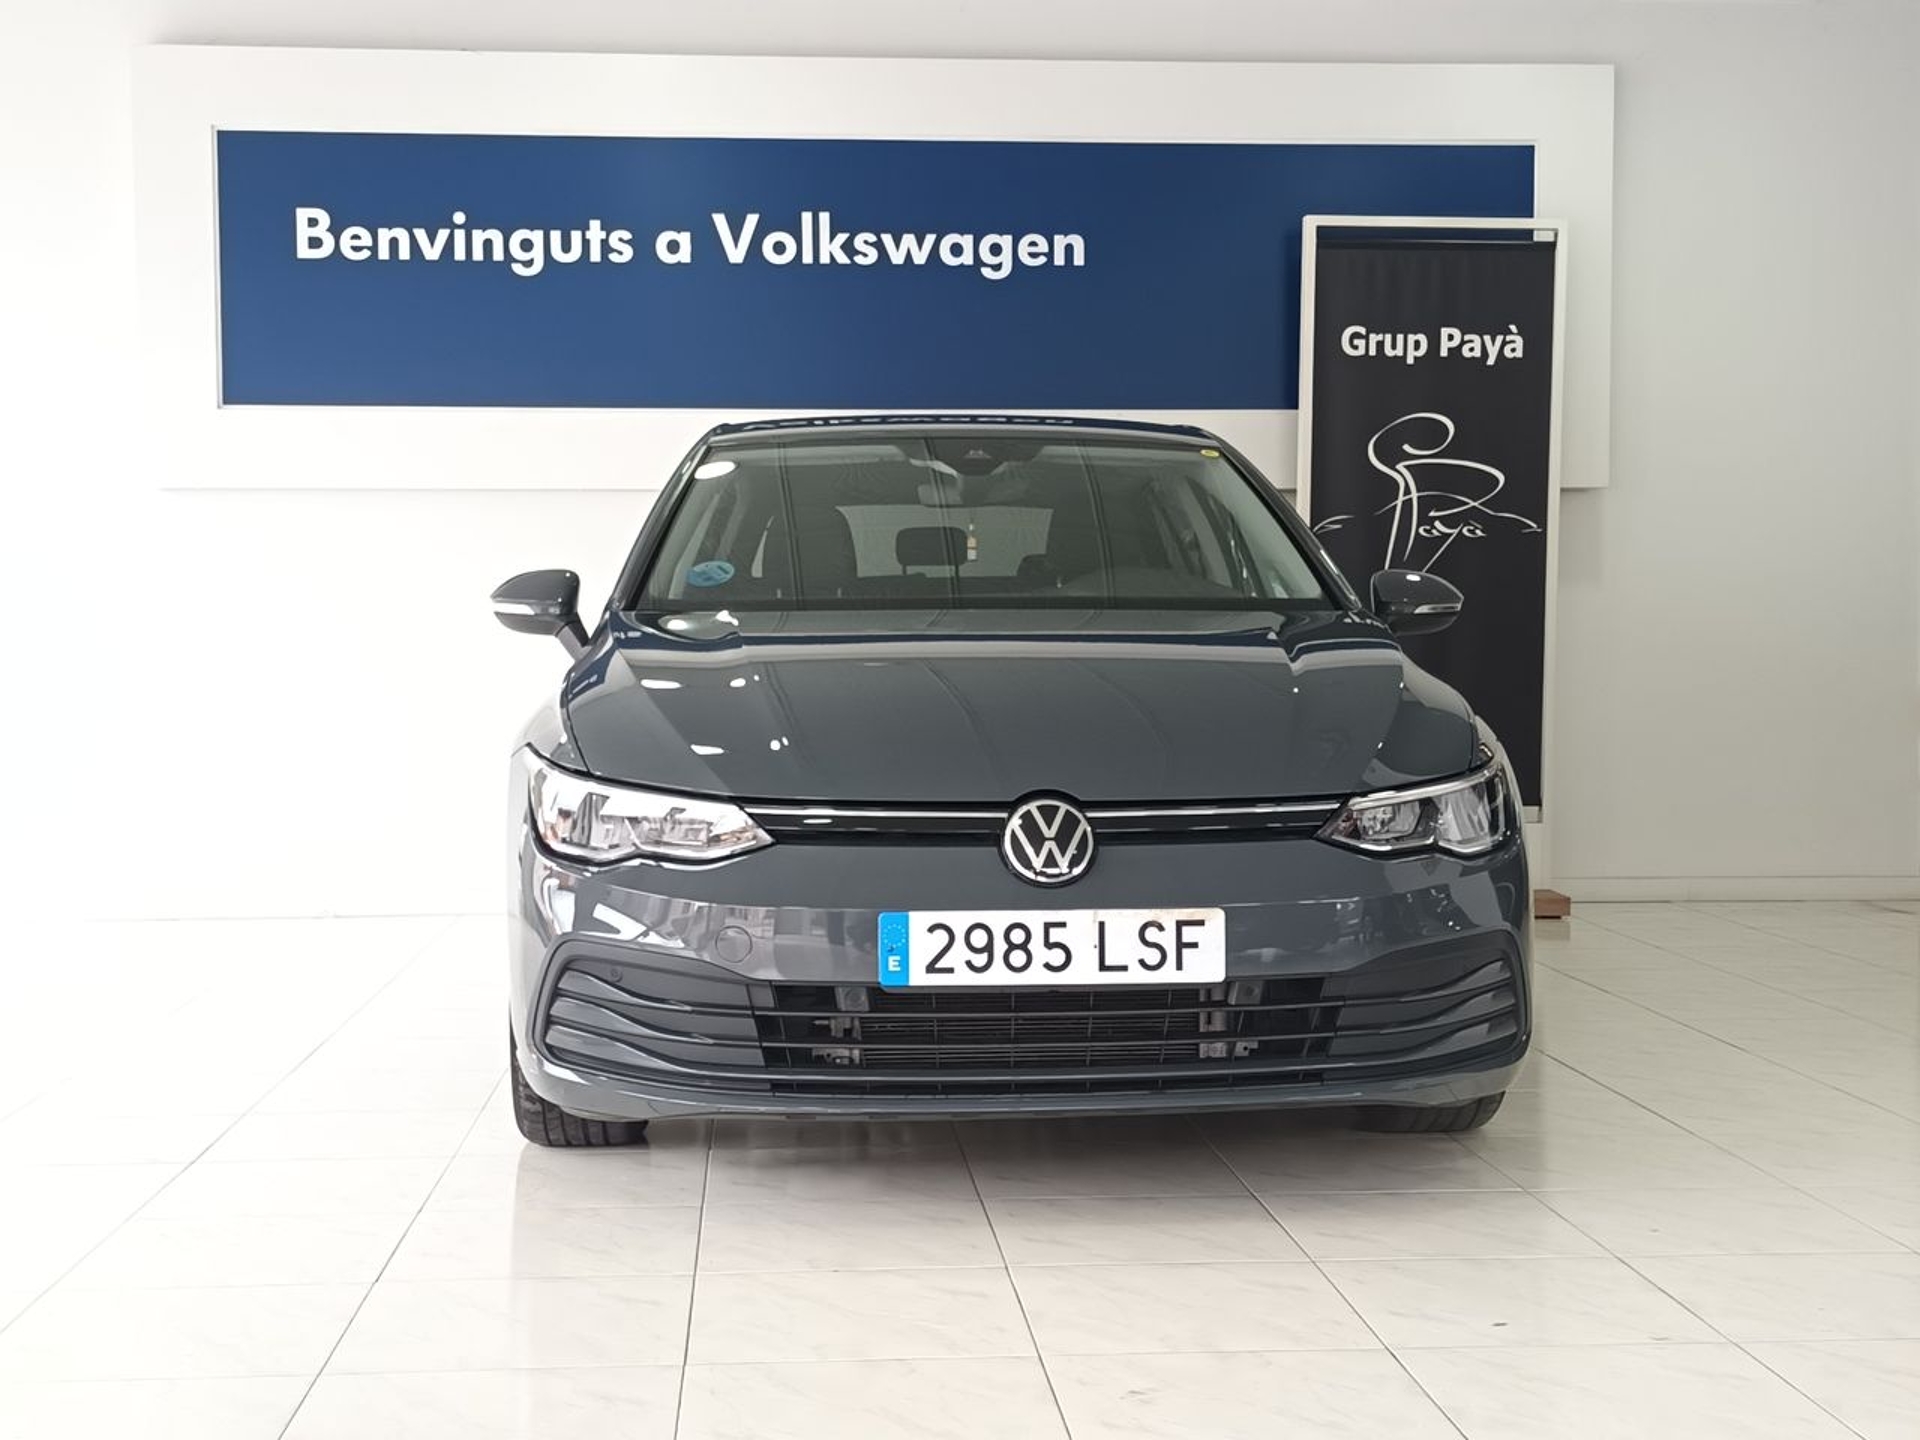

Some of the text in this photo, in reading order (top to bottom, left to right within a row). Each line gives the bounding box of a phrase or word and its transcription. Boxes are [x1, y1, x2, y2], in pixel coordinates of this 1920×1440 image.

[295, 207, 1086, 280] Benvinguts a Volkswagen
[1340, 324, 1524, 365] Grup Payà
[887, 954, 902, 972] E
[925, 919, 1206, 974] 2985 LSF
